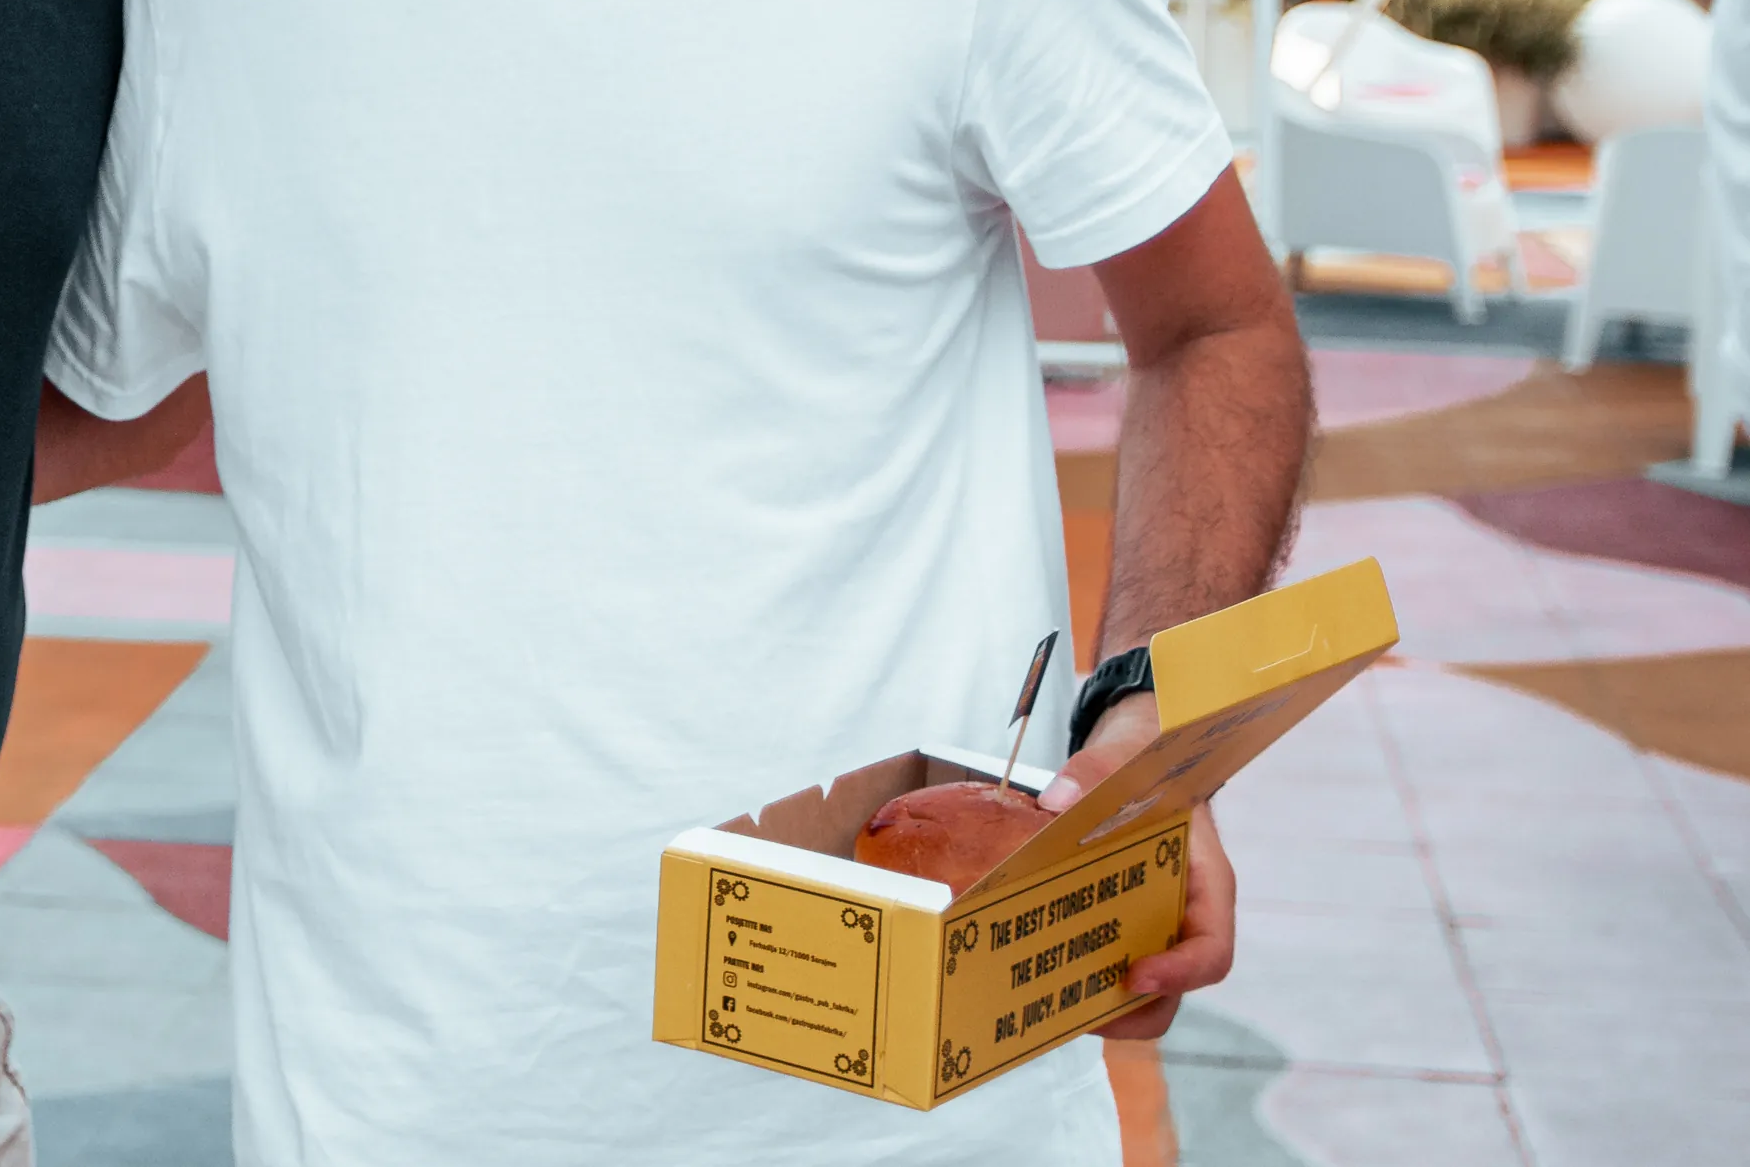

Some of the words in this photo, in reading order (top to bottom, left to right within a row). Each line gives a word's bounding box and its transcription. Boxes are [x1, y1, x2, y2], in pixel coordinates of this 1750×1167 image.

[990, 919, 1013, 951] THE
[1015, 905, 1046, 941] BEST
[1047, 883, 1095, 927] STORIES
[1097, 872, 1119, 904] ARE
[1121, 860, 1147, 893] LIKE
[1011, 957, 1033, 989] THE
[1035, 942, 1065, 978] BEST
[1058, 980, 1082, 1012] AND
